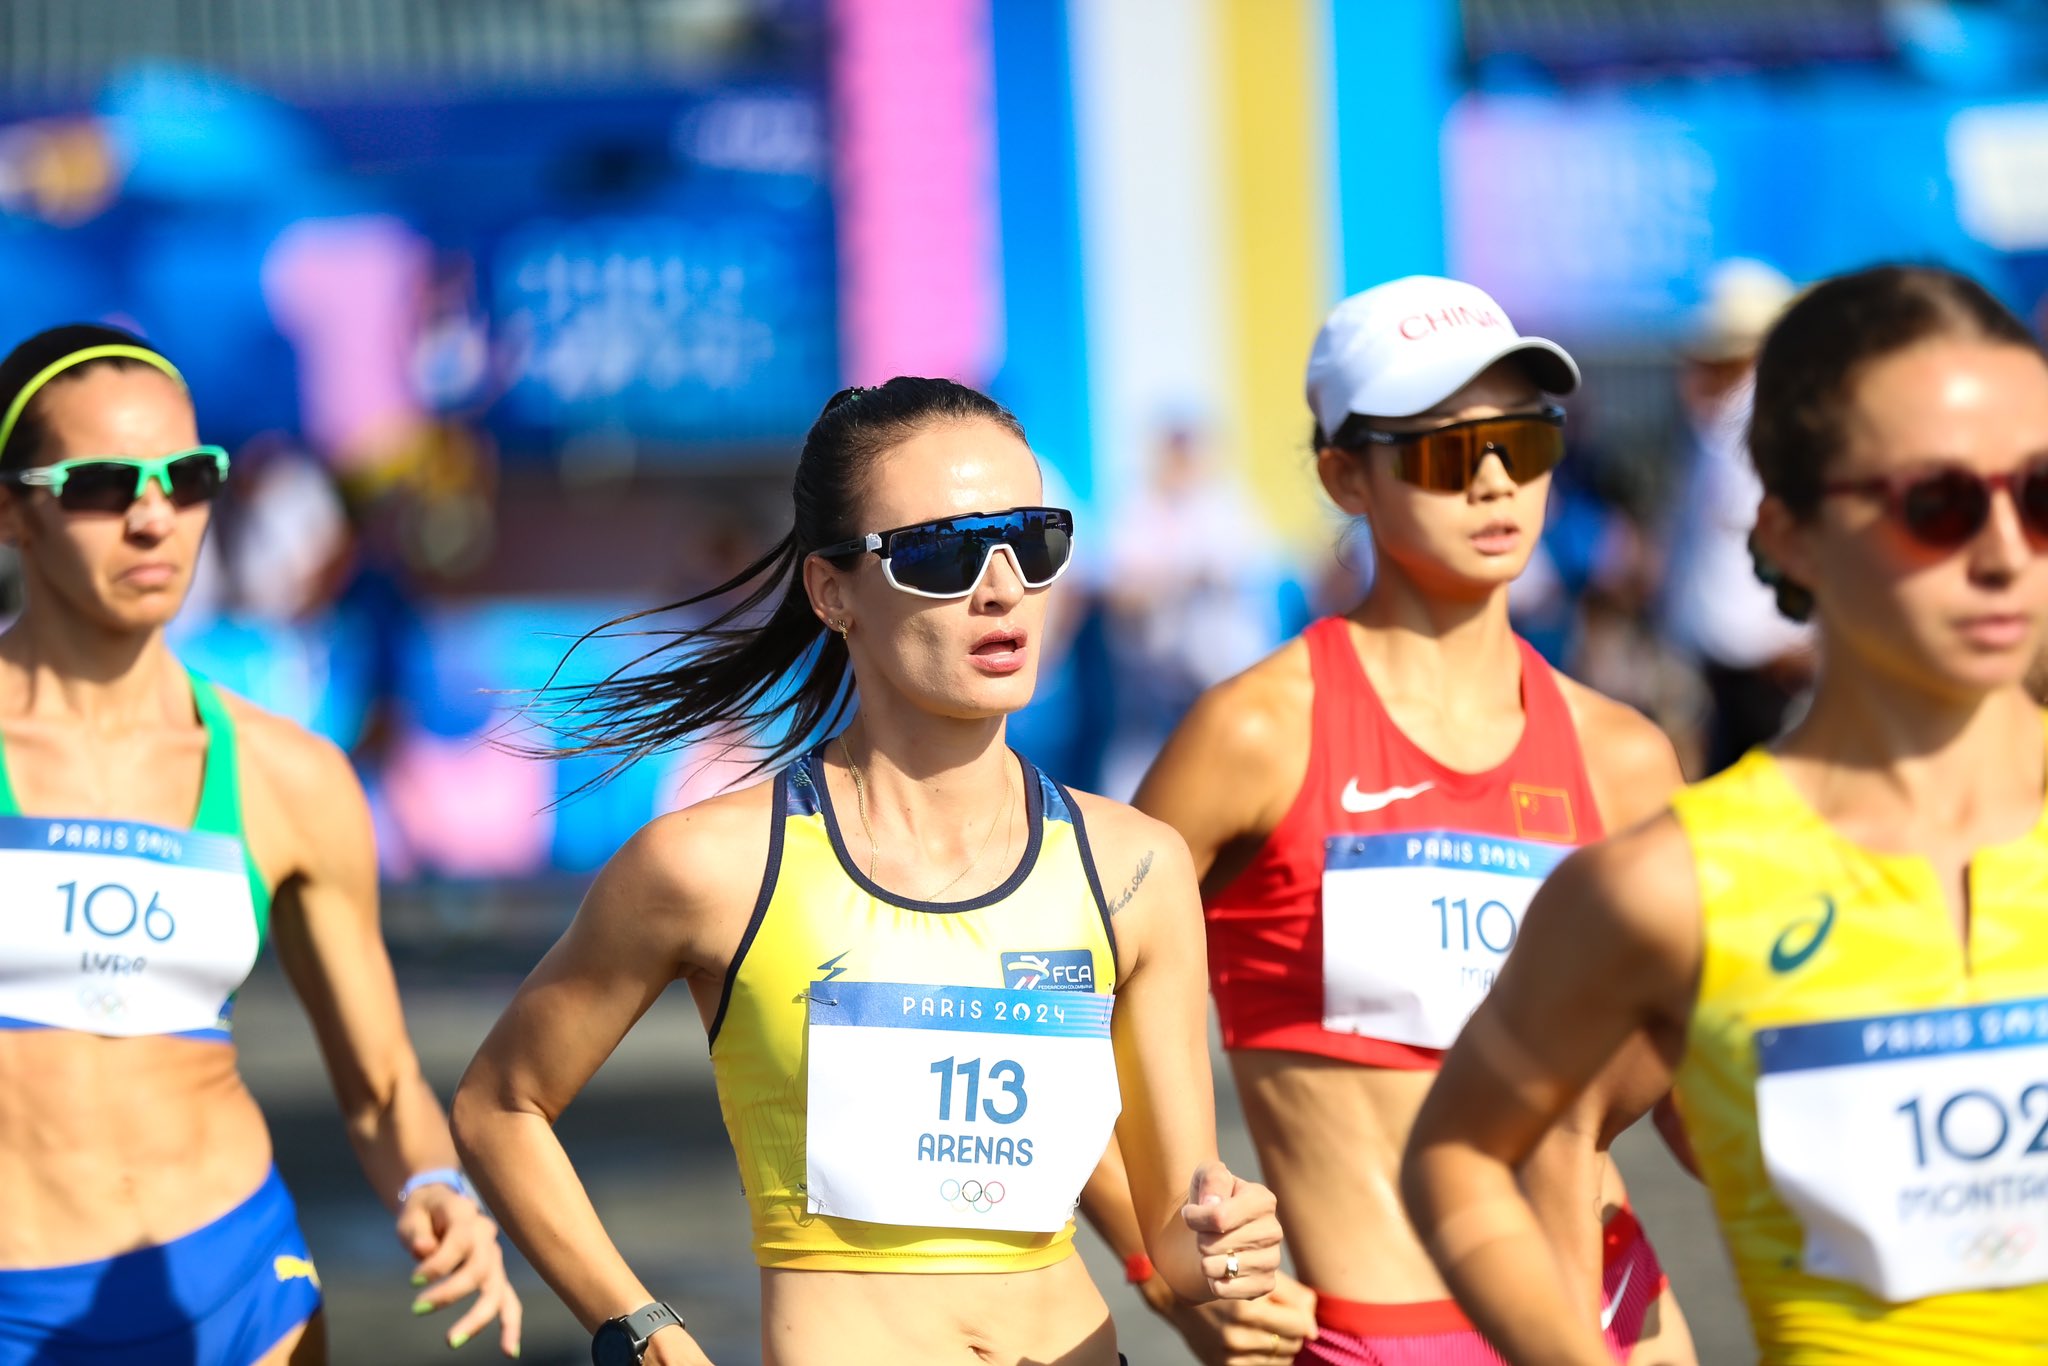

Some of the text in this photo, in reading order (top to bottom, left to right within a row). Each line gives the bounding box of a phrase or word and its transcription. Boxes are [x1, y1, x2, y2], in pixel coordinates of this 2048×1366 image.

[1398, 306, 1505, 340] CHINA
[135, 829, 182, 859] 2024
[1479, 843, 1530, 870] 2024
[56, 880, 175, 942] 106
[1431, 896, 1516, 954] 110
[1052, 965, 1092, 983] FCA
[994, 1001, 1065, 1024] 2024
[930, 1055, 1028, 1125] 113
[1896, 1081, 2048, 1168] 102
[917, 1133, 1034, 1167] ARENAS
